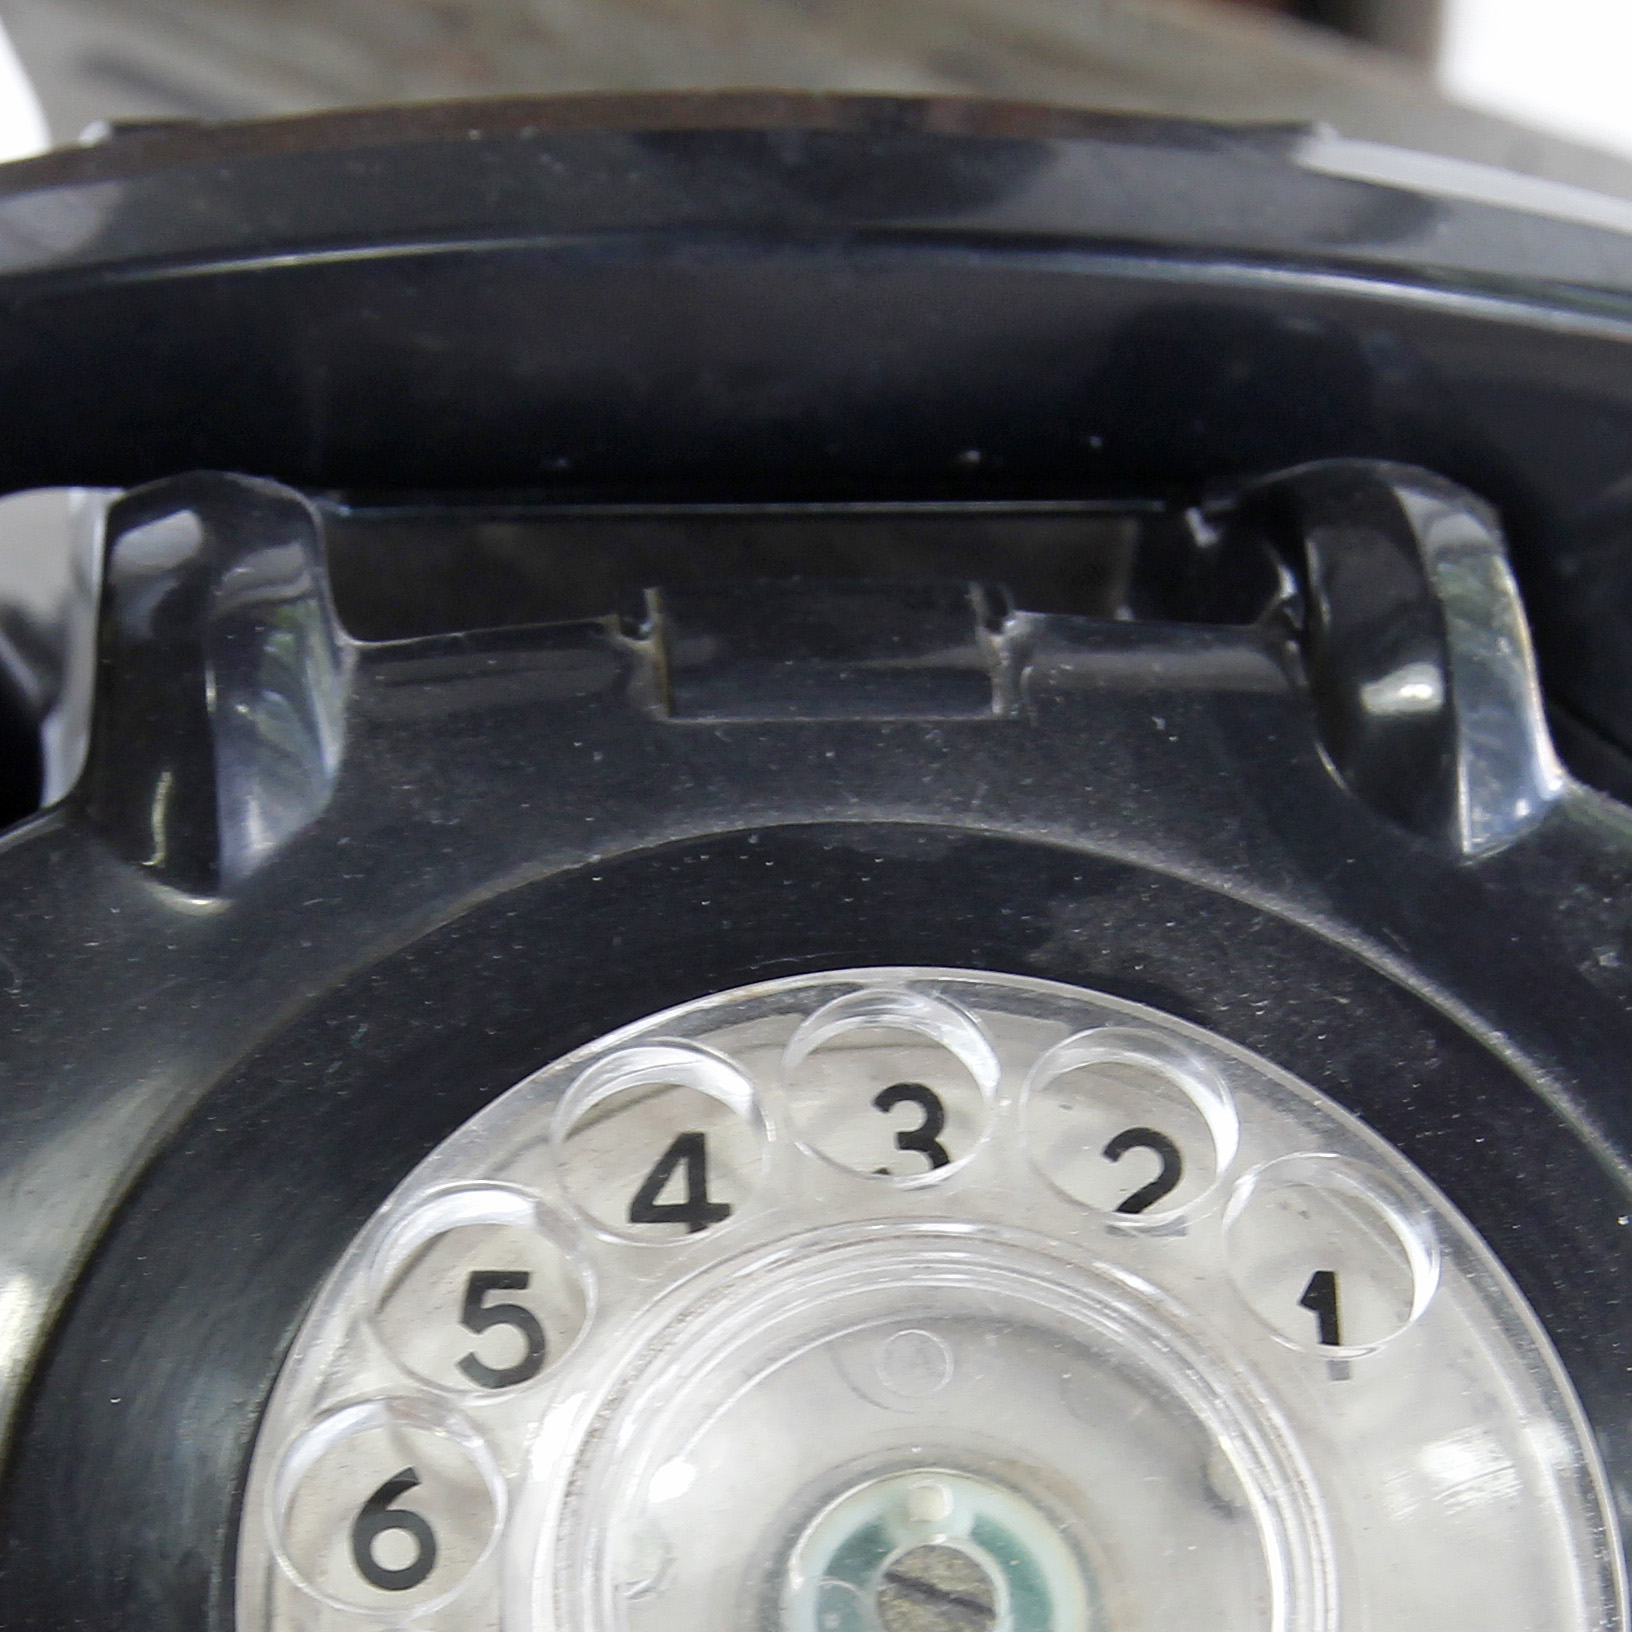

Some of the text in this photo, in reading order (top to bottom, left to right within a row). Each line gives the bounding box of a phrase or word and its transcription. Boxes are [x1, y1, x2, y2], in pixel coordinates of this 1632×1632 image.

[628, 1131, 732, 1235] 4
[872, 1082, 952, 1176] 3
[1101, 1126, 1189, 1236] 2
[456, 1269, 548, 1391] 5
[1297, 1269, 1352, 1382] 1
[351, 1465, 438, 1592] 6
